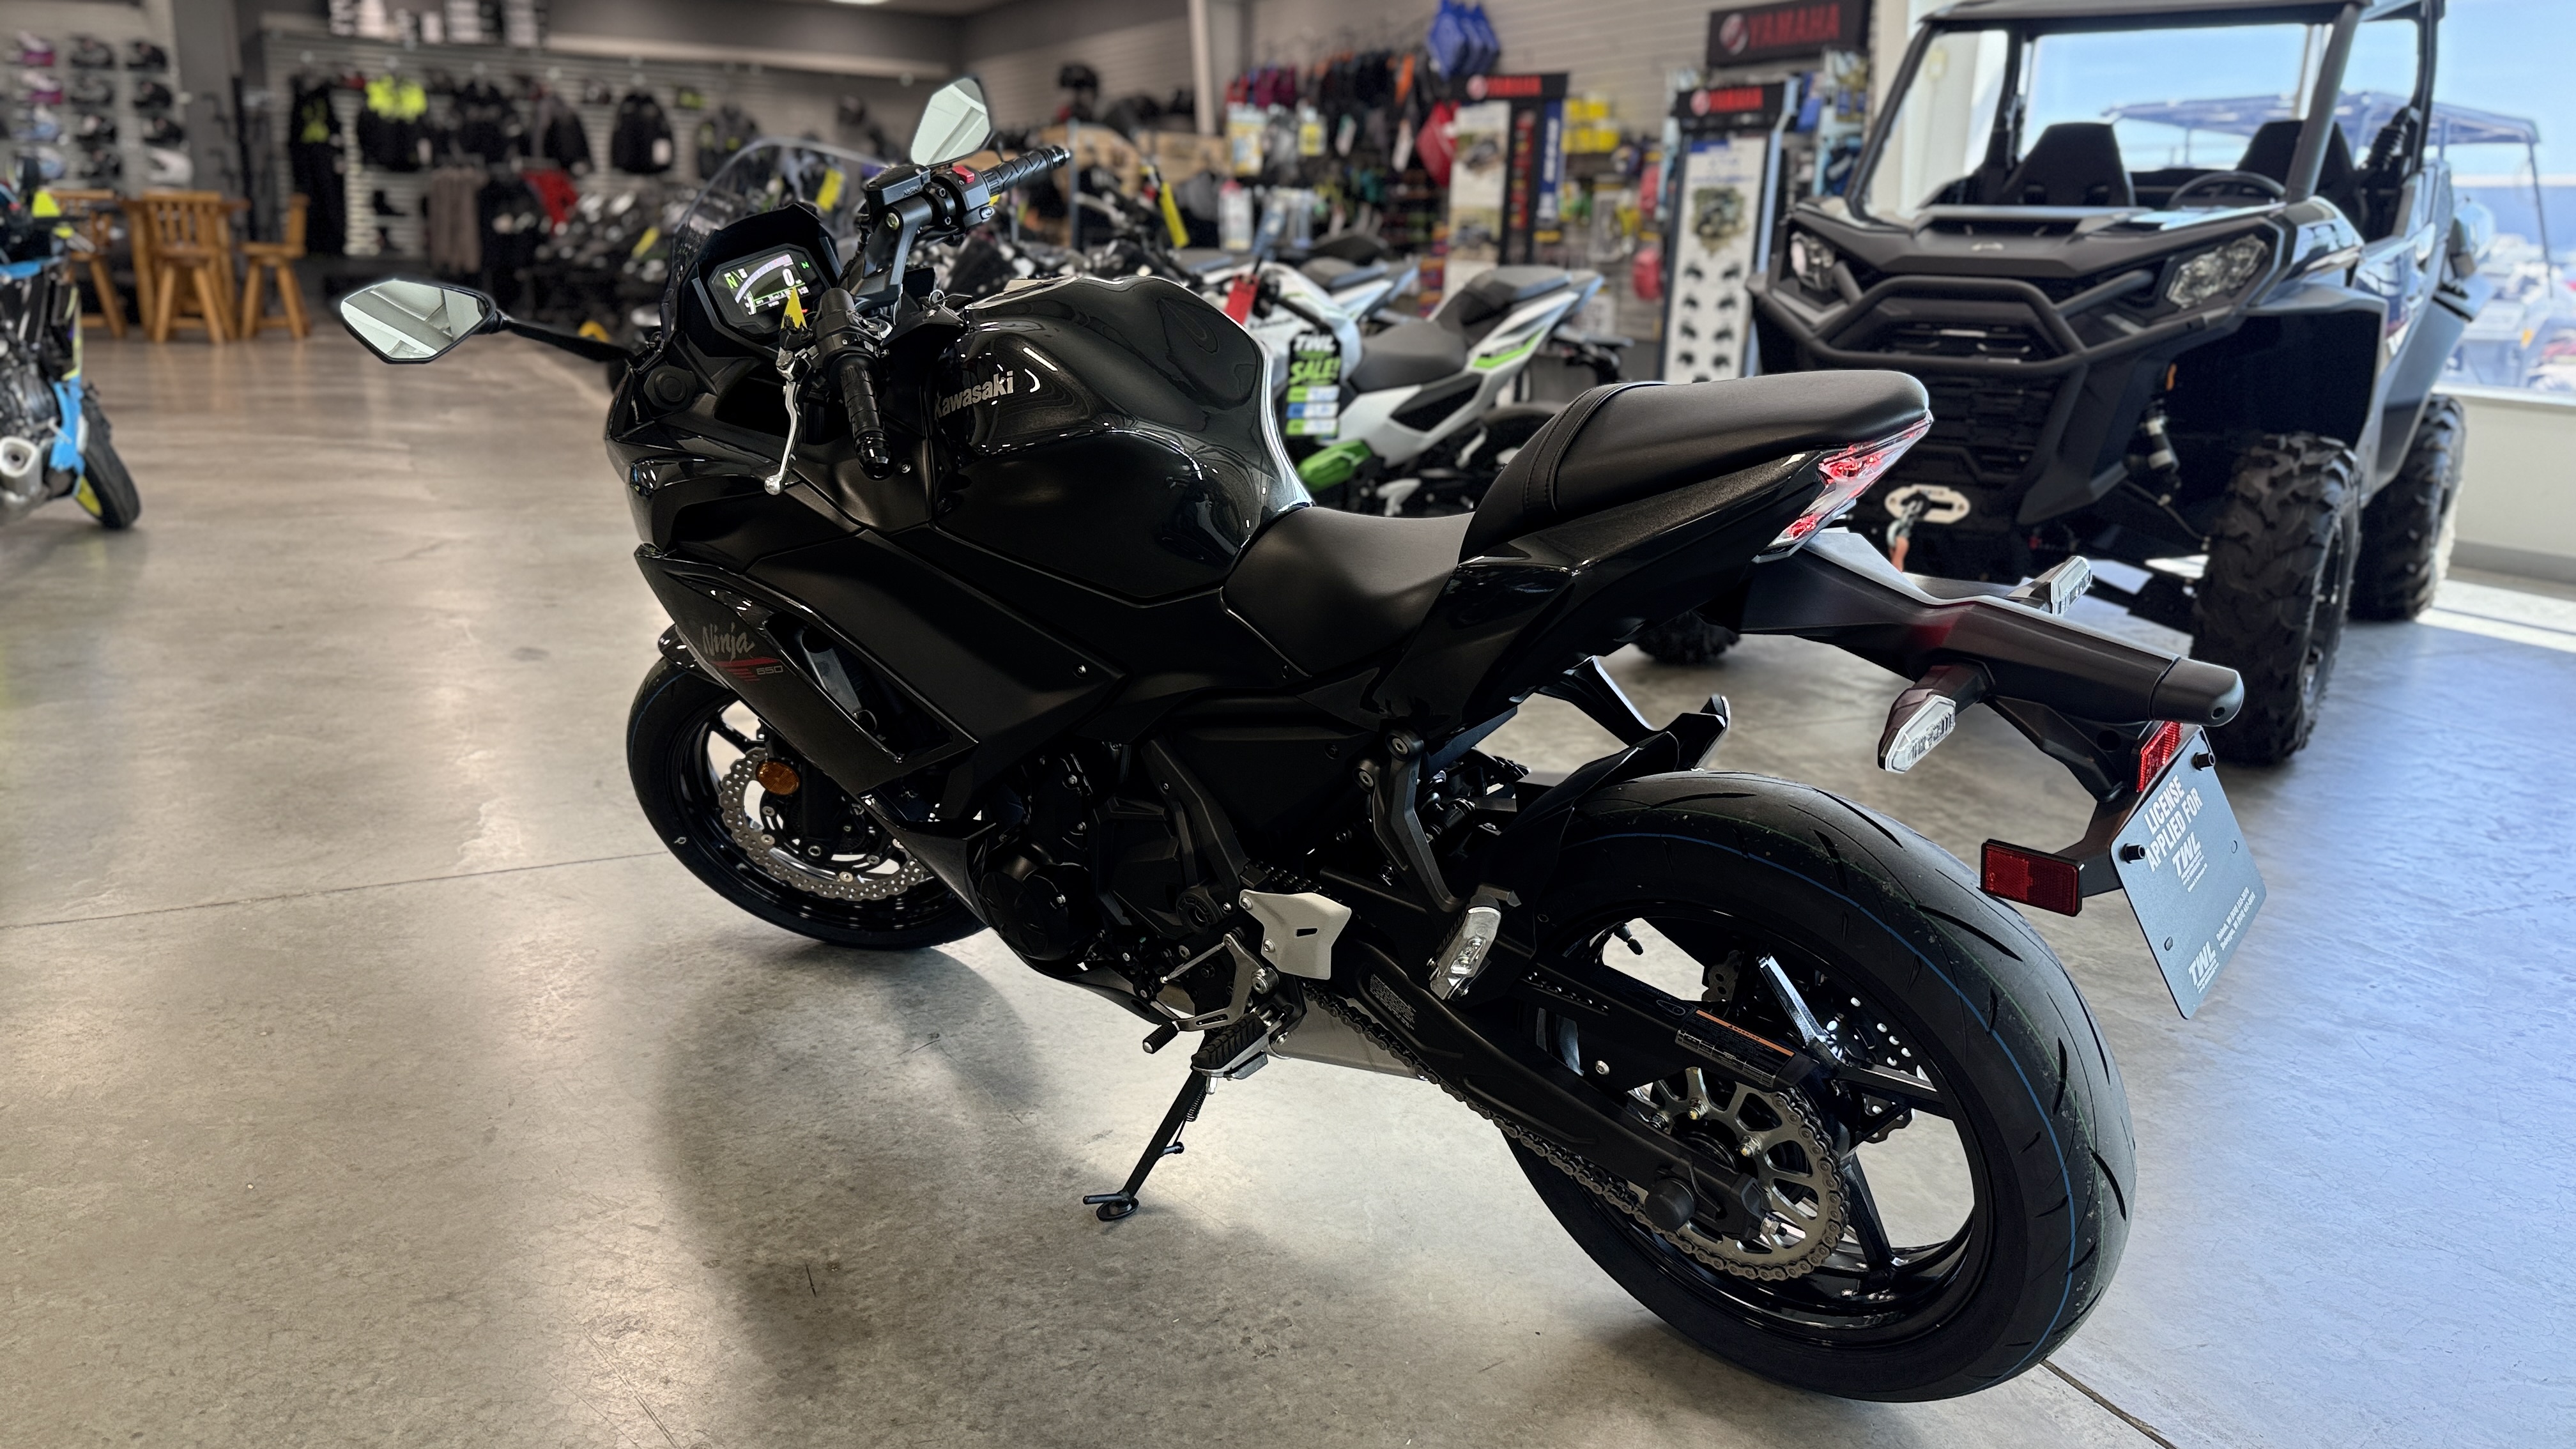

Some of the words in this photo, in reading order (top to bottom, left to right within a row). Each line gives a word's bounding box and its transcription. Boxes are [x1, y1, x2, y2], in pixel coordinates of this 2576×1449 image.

[1749, 3, 1839, 49] YAMAHA
[725, 276, 739, 289] N
[782, 268, 795, 287] 0
[1294, 334, 1337, 352] TWL
[1289, 355, 1341, 385] SALE!
[934, 370, 1014, 420] Kawasaki
[703, 622, 755, 662] Ninja
[756, 665, 783, 675] 650
[2143, 774, 2185, 836] LICENSE
[2145, 810, 2186, 873] APPLIED
[2181, 787, 2203, 824] FOR
[2172, 831, 2202, 877] TWL
[2188, 940, 2216, 986] TWL
